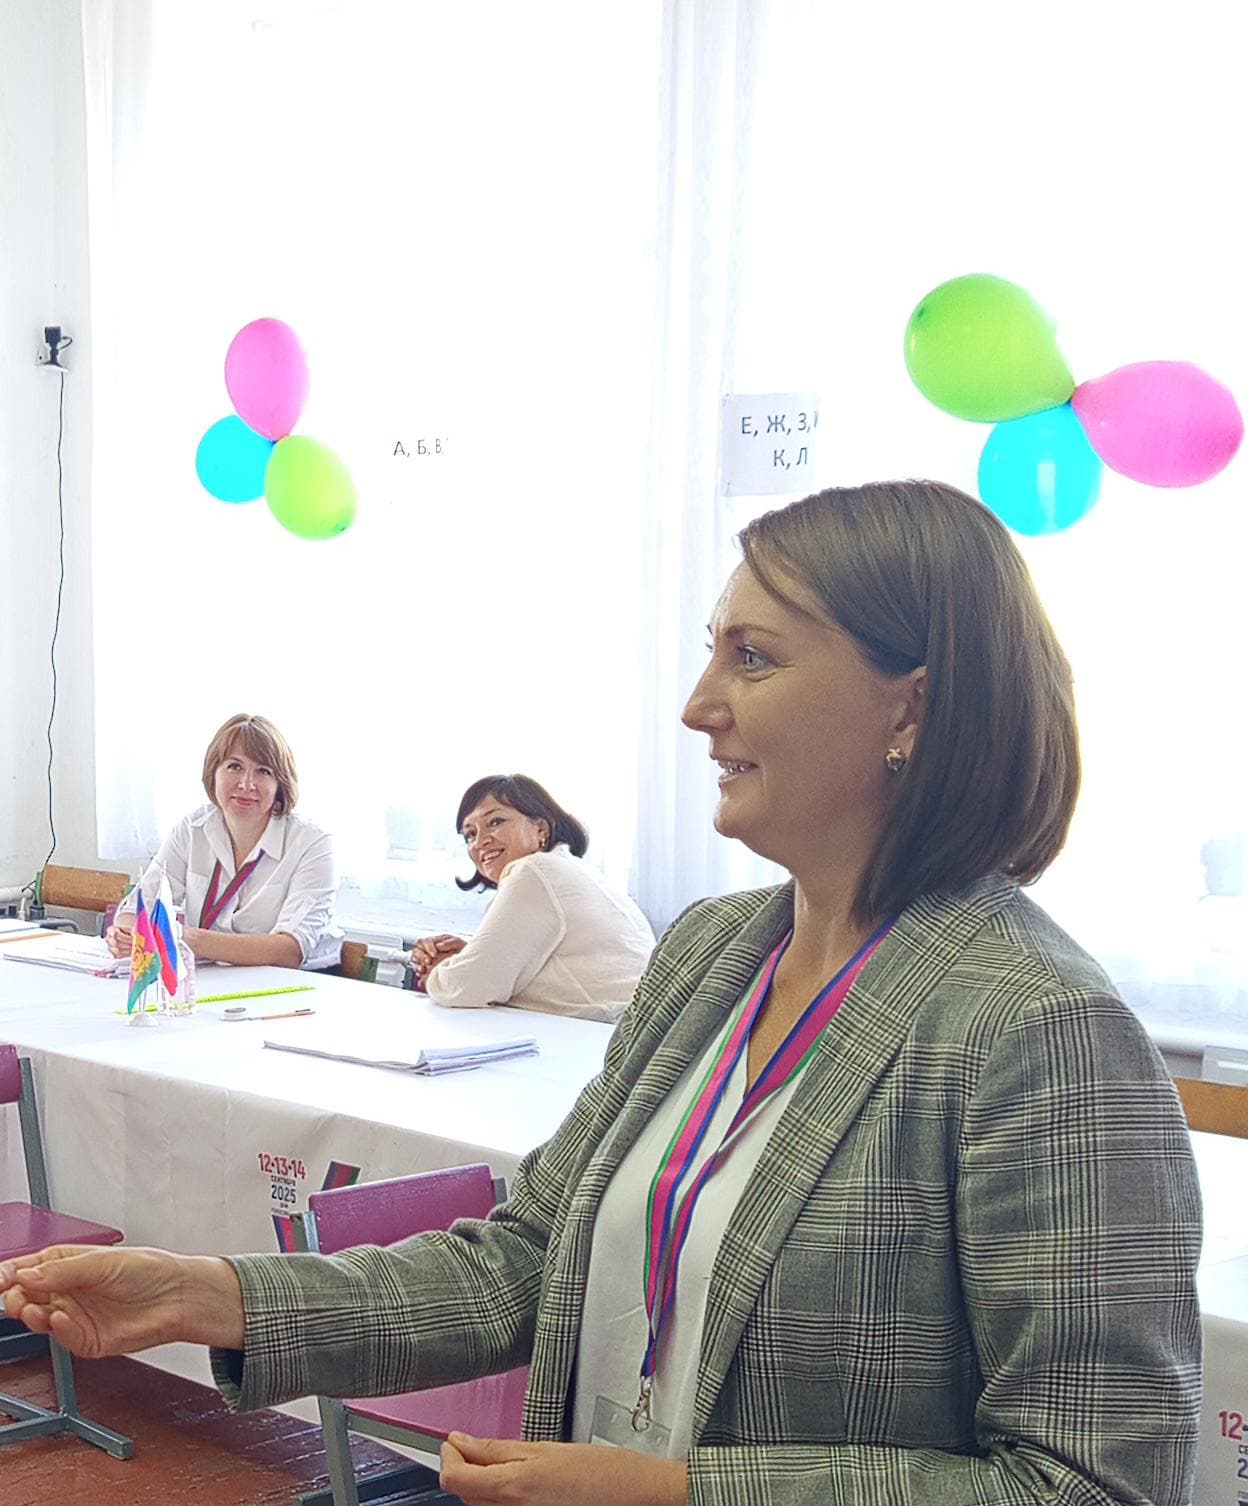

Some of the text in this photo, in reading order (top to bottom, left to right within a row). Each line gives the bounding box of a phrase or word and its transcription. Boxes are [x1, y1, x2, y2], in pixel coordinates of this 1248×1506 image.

[741, 415, 758, 438] Е,
[766, 414, 791, 436] Ж,
[393, 441, 410, 458] А,
[773, 446, 808, 470] К, Л
[271, 1185, 296, 1204] 2025
